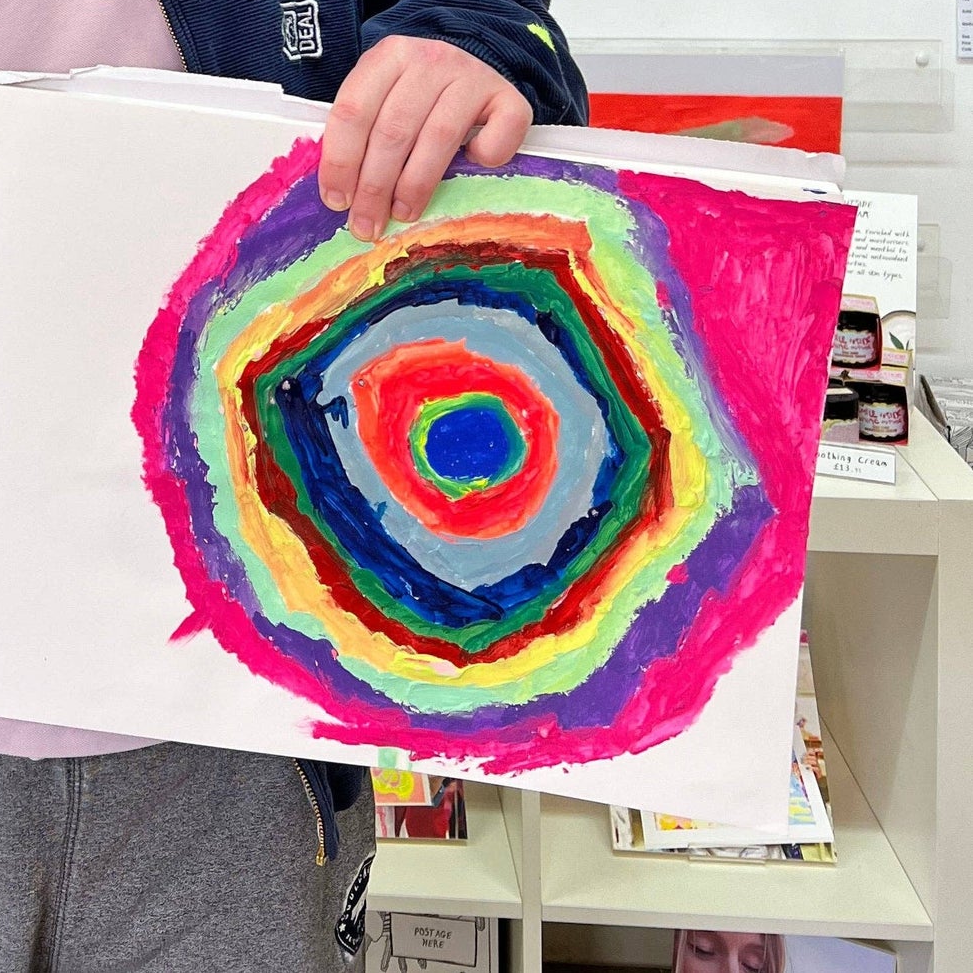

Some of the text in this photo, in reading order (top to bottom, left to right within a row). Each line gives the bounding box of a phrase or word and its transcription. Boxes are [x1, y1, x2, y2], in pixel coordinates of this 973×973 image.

[297, 6, 316, 52] DEAL
[858, 456, 888, 467] Cream
[413, 927, 453, 941] POSTAGE
[421, 937, 445, 949] HERE
